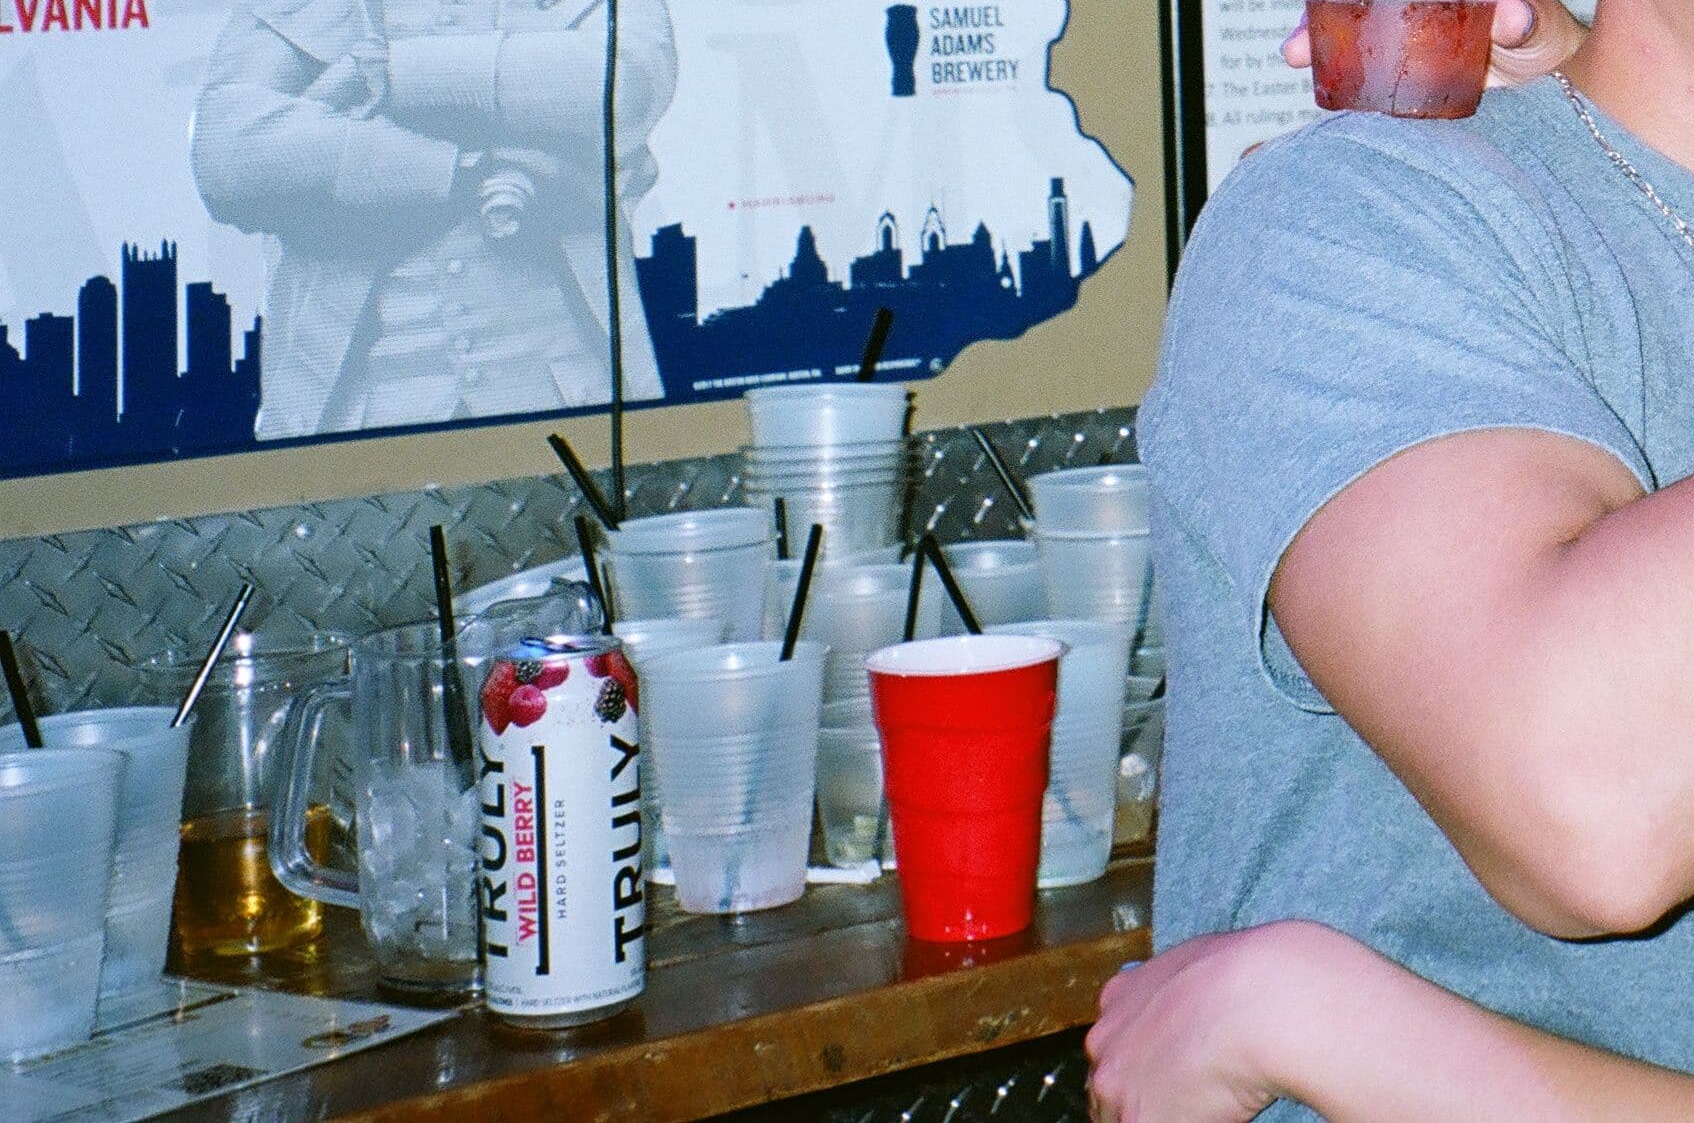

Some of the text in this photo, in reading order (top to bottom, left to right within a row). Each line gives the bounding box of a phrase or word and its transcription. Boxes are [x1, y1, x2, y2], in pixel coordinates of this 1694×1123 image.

[929, 5, 1005, 29] SAMUEL
[930, 32, 995, 57] ADAMS
[931, 59, 1019, 84] BREWERY
[481, 745, 509, 960] TRULY
[512, 780, 538, 944] WILD BERRY
[553, 798, 568, 920] HARD SELTZER
[610, 734, 644, 964] TRULY
